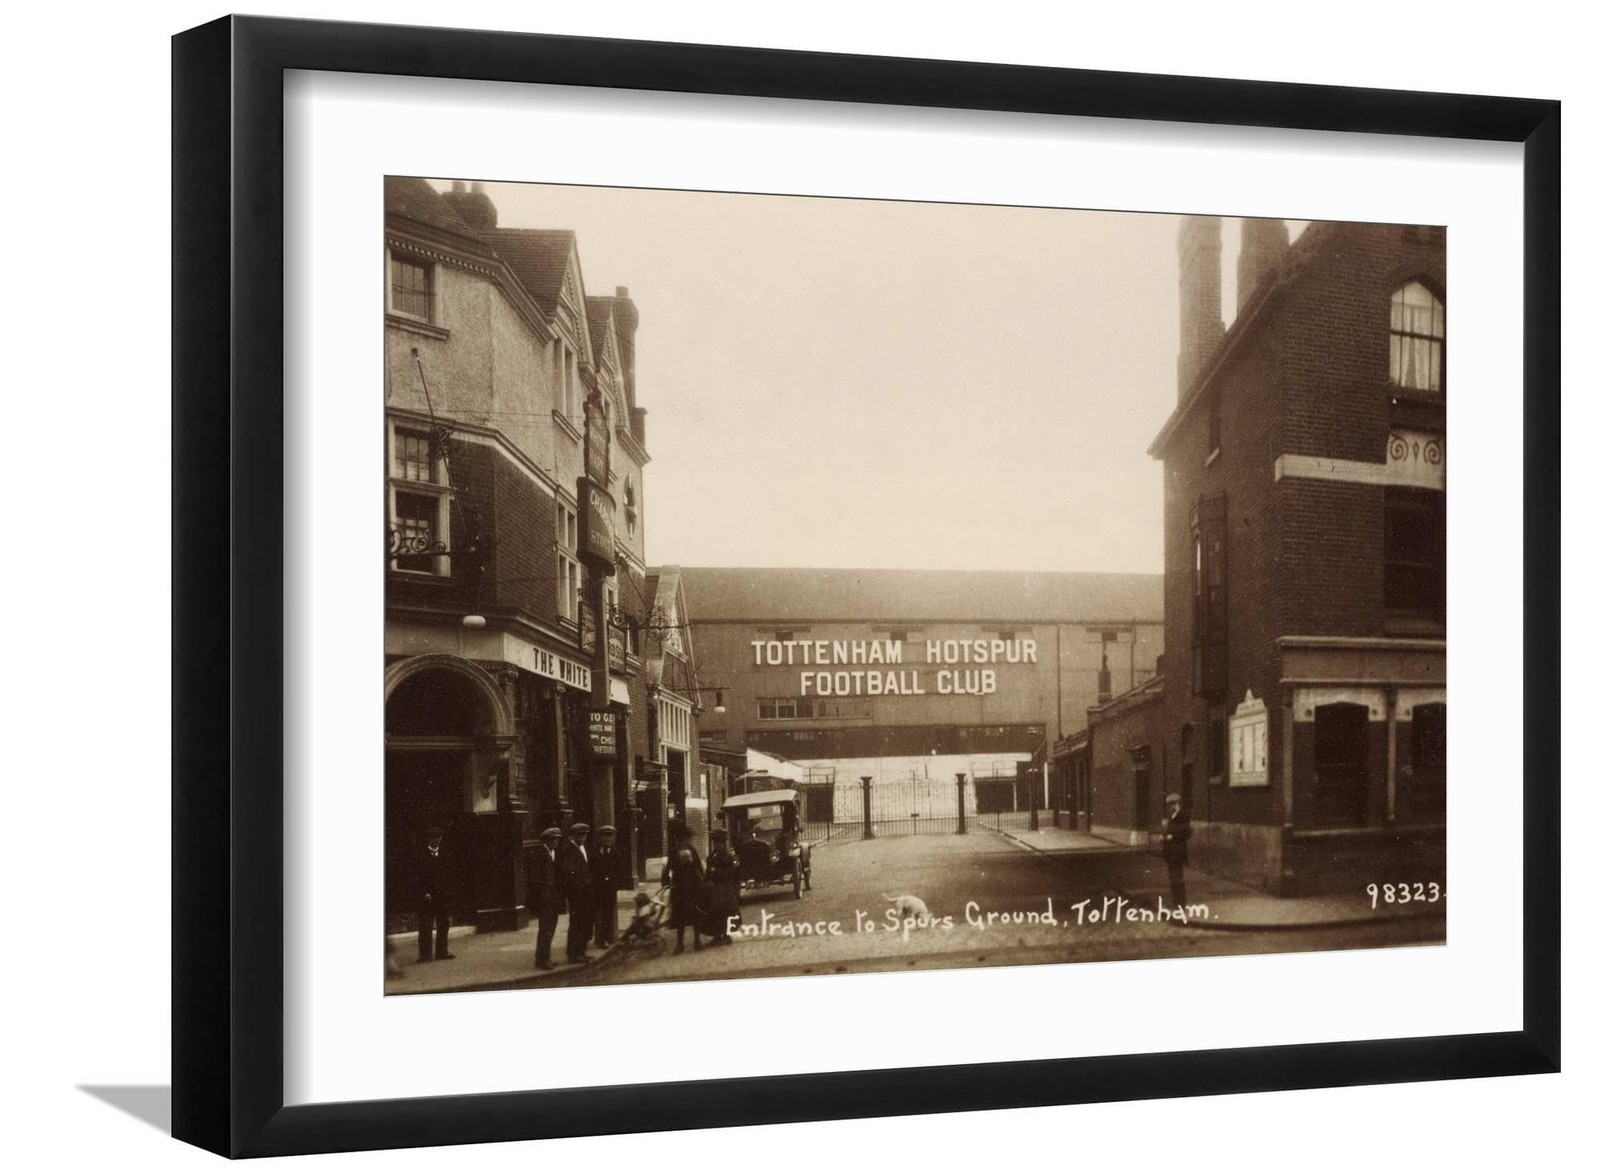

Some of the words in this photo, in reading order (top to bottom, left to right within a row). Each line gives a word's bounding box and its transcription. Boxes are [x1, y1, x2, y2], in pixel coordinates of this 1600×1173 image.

[751, 640, 902, 665] TOTTENHAM
[926, 639, 1038, 664] HOTSPUR
[533, 647, 555, 675] THE
[558, 658, 589, 688] WHITE
[800, 670, 925, 696] FOOTBALL
[937, 669, 997, 696] CLUB
